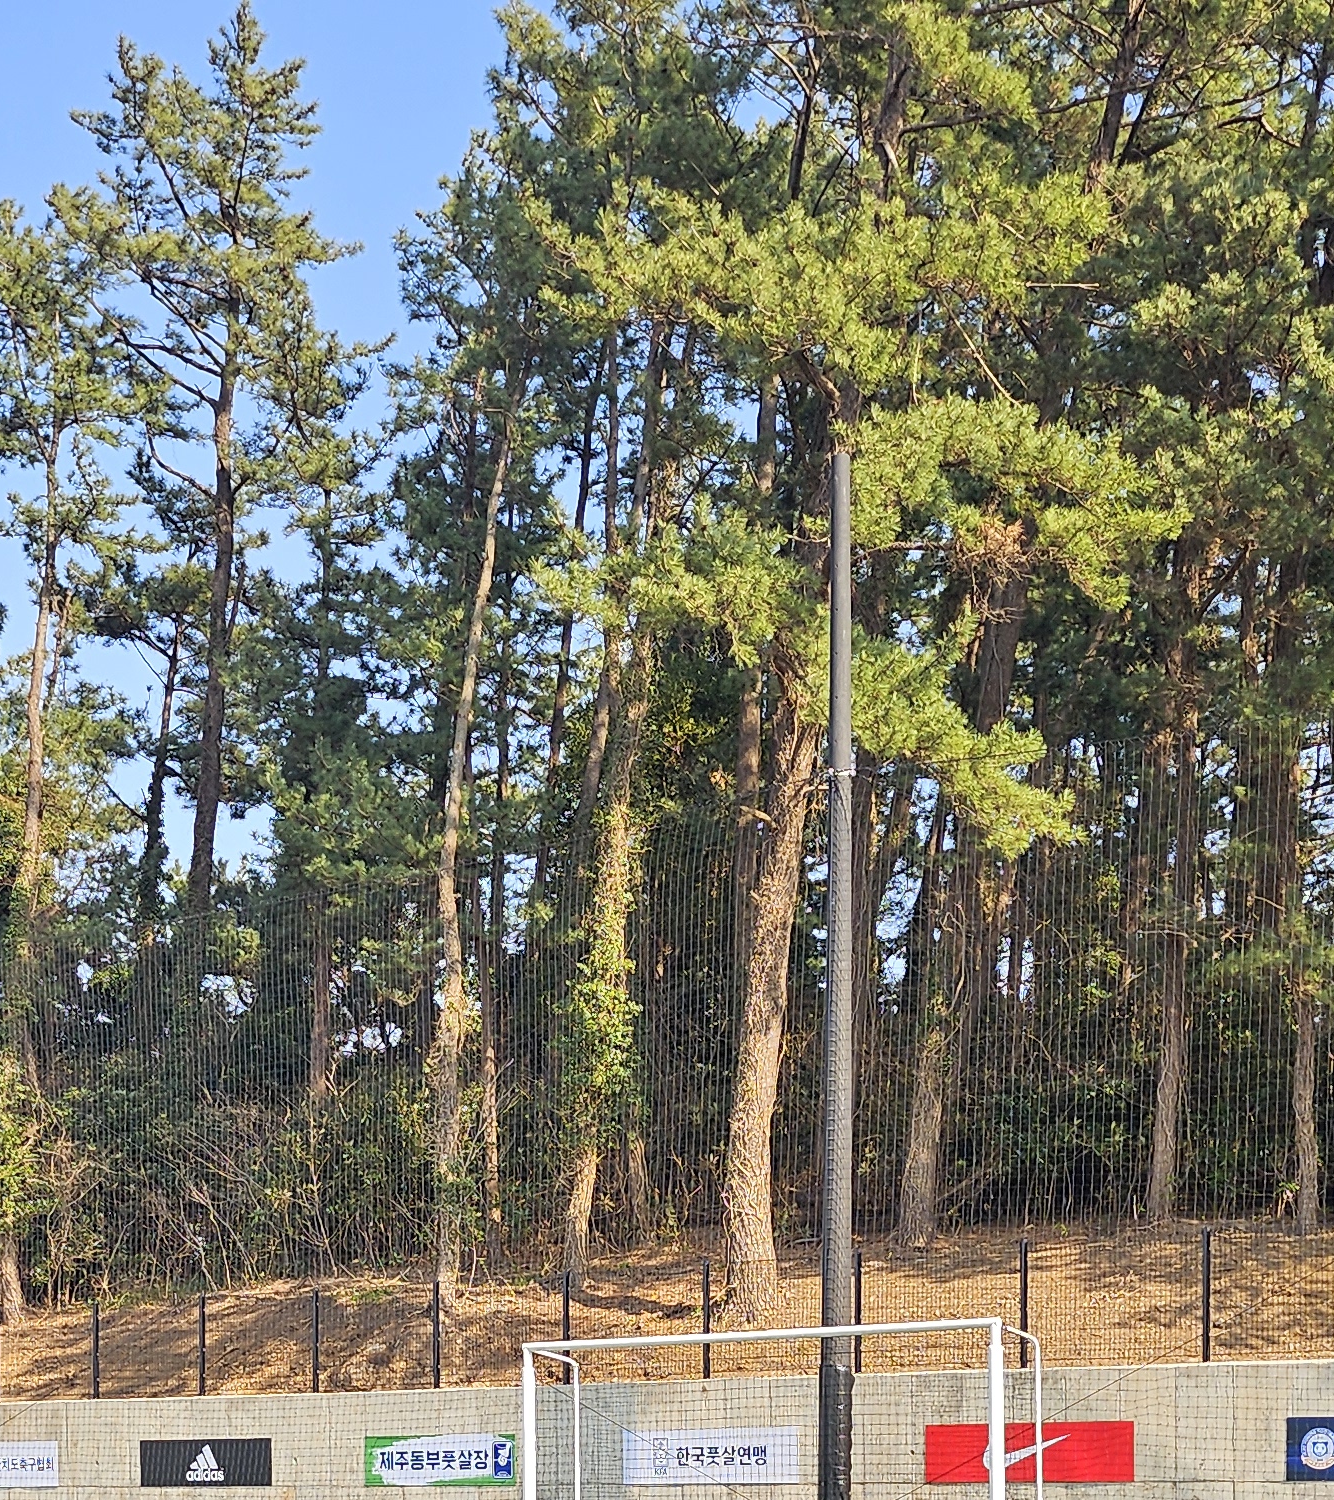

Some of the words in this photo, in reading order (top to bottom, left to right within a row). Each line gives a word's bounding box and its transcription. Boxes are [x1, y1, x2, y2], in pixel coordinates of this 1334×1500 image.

[379, 1448, 489, 1472] 제주동부풋살장
[676, 1445, 767, 1467] 한국풋살연맹
[186, 1466, 225, 1482] adidas
